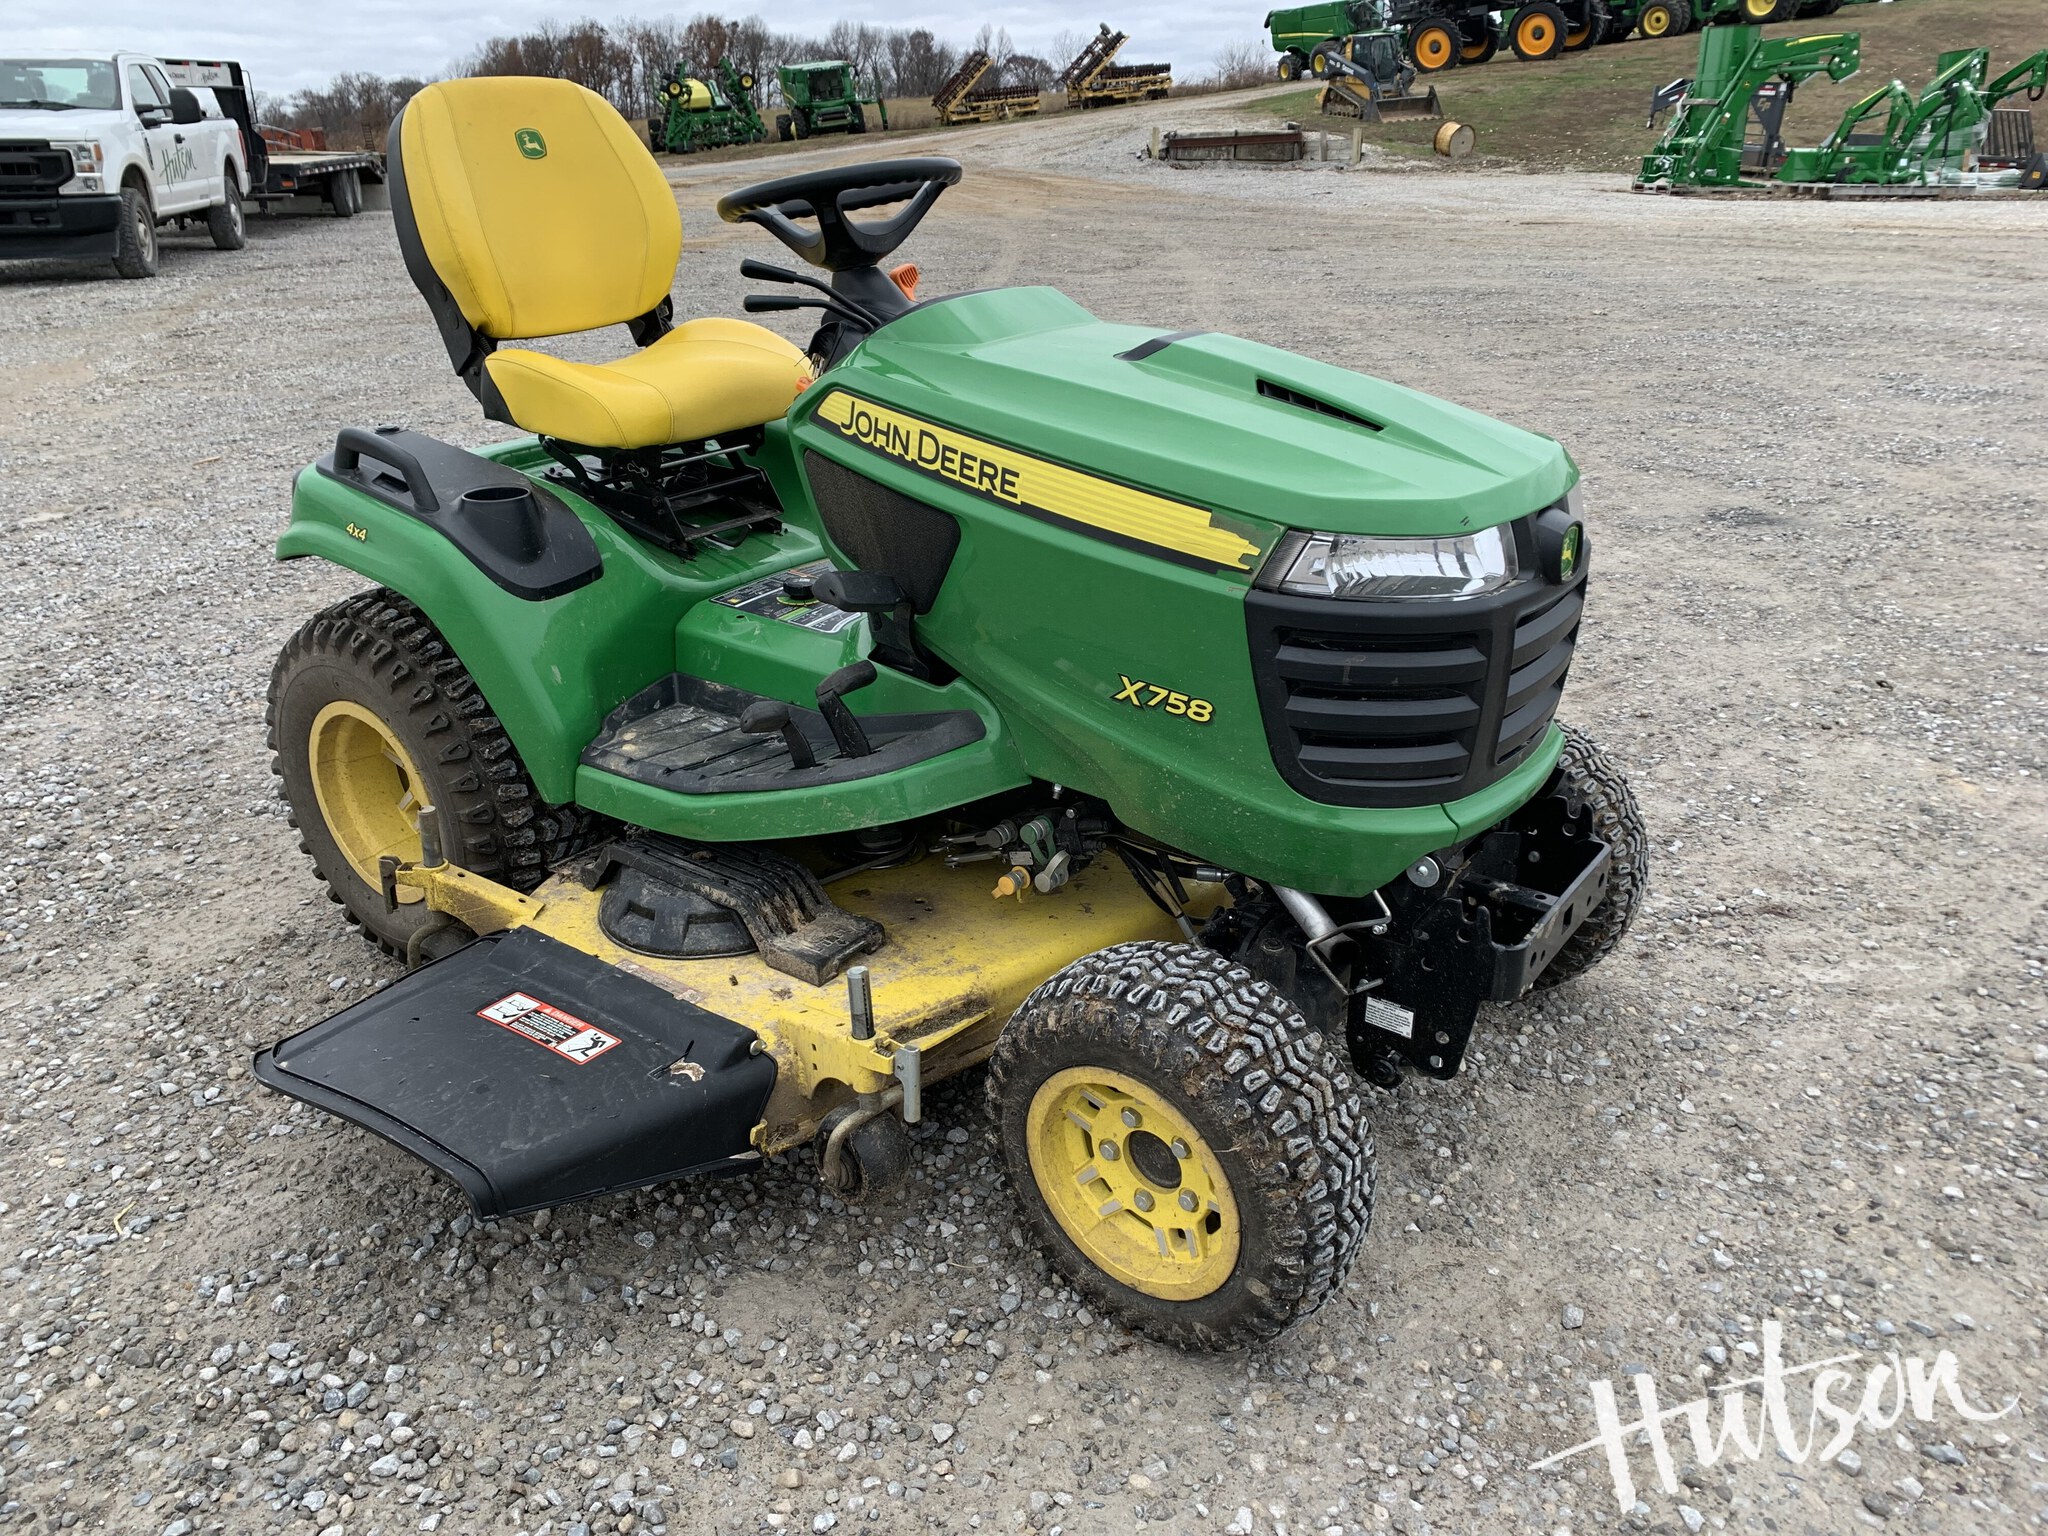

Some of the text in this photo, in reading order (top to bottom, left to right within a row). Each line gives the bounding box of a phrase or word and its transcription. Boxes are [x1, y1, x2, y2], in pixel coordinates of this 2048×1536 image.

[159, 143, 197, 193] Hutson
[840, 401, 1020, 500] JOHN DEERE
[346, 522, 367, 541] 4x4
[1112, 674, 1215, 722] X758
[551, 1010, 586, 1027] DANGER
